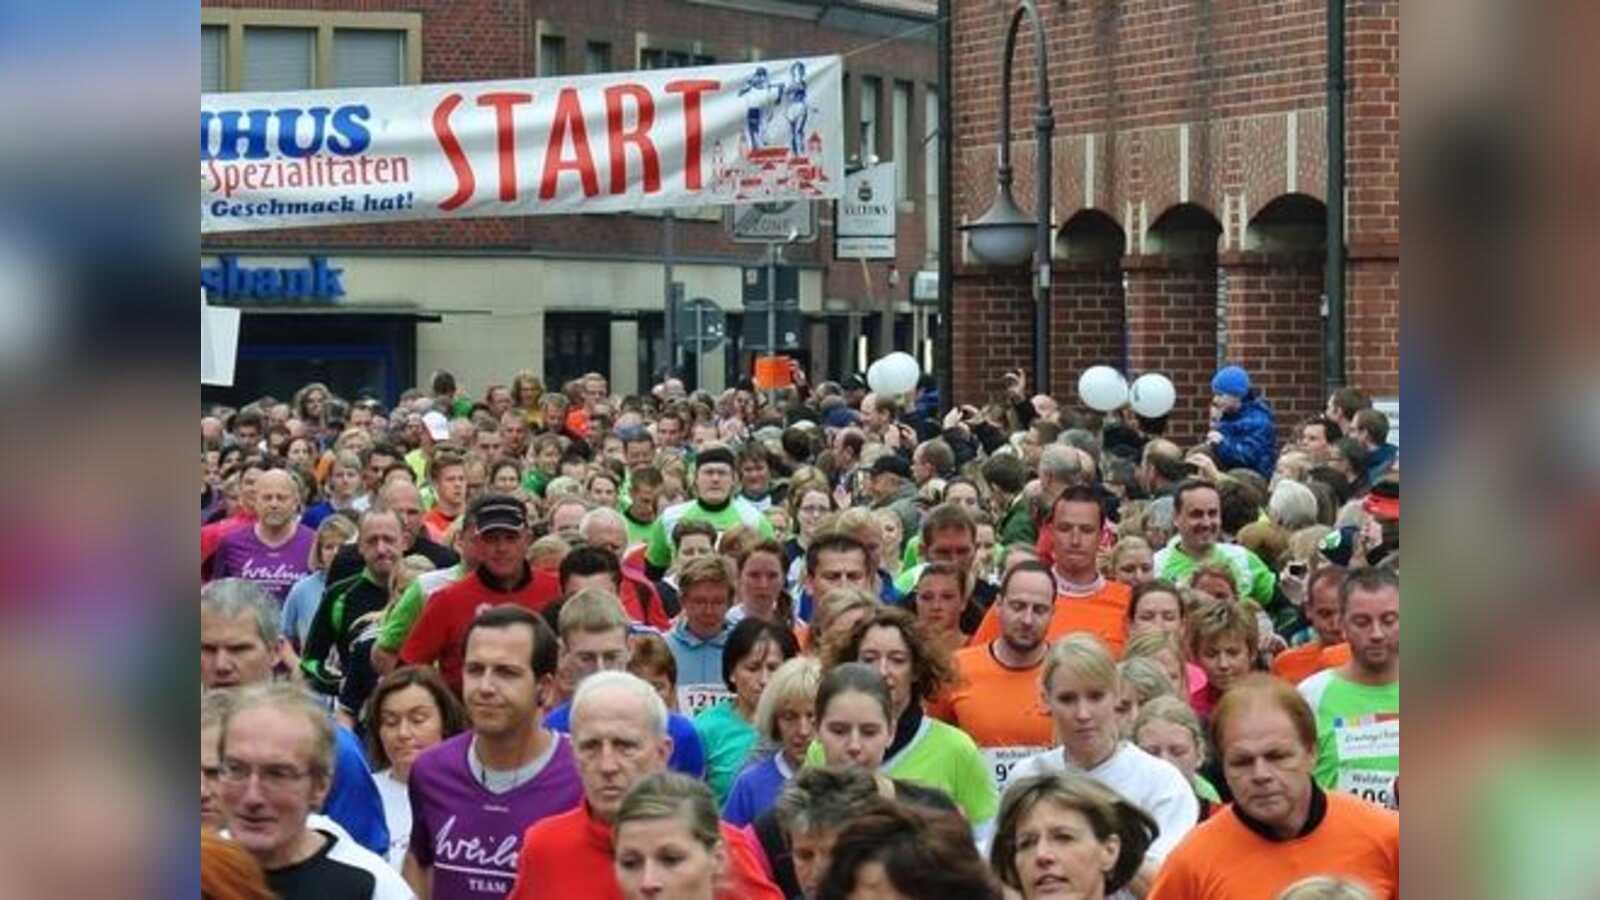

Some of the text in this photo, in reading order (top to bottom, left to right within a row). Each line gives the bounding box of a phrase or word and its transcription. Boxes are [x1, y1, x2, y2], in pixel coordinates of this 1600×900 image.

[432, 79, 721, 211] START
[211, 192, 414, 217] Geschmack hat!
[688, 694, 733, 707] 121
